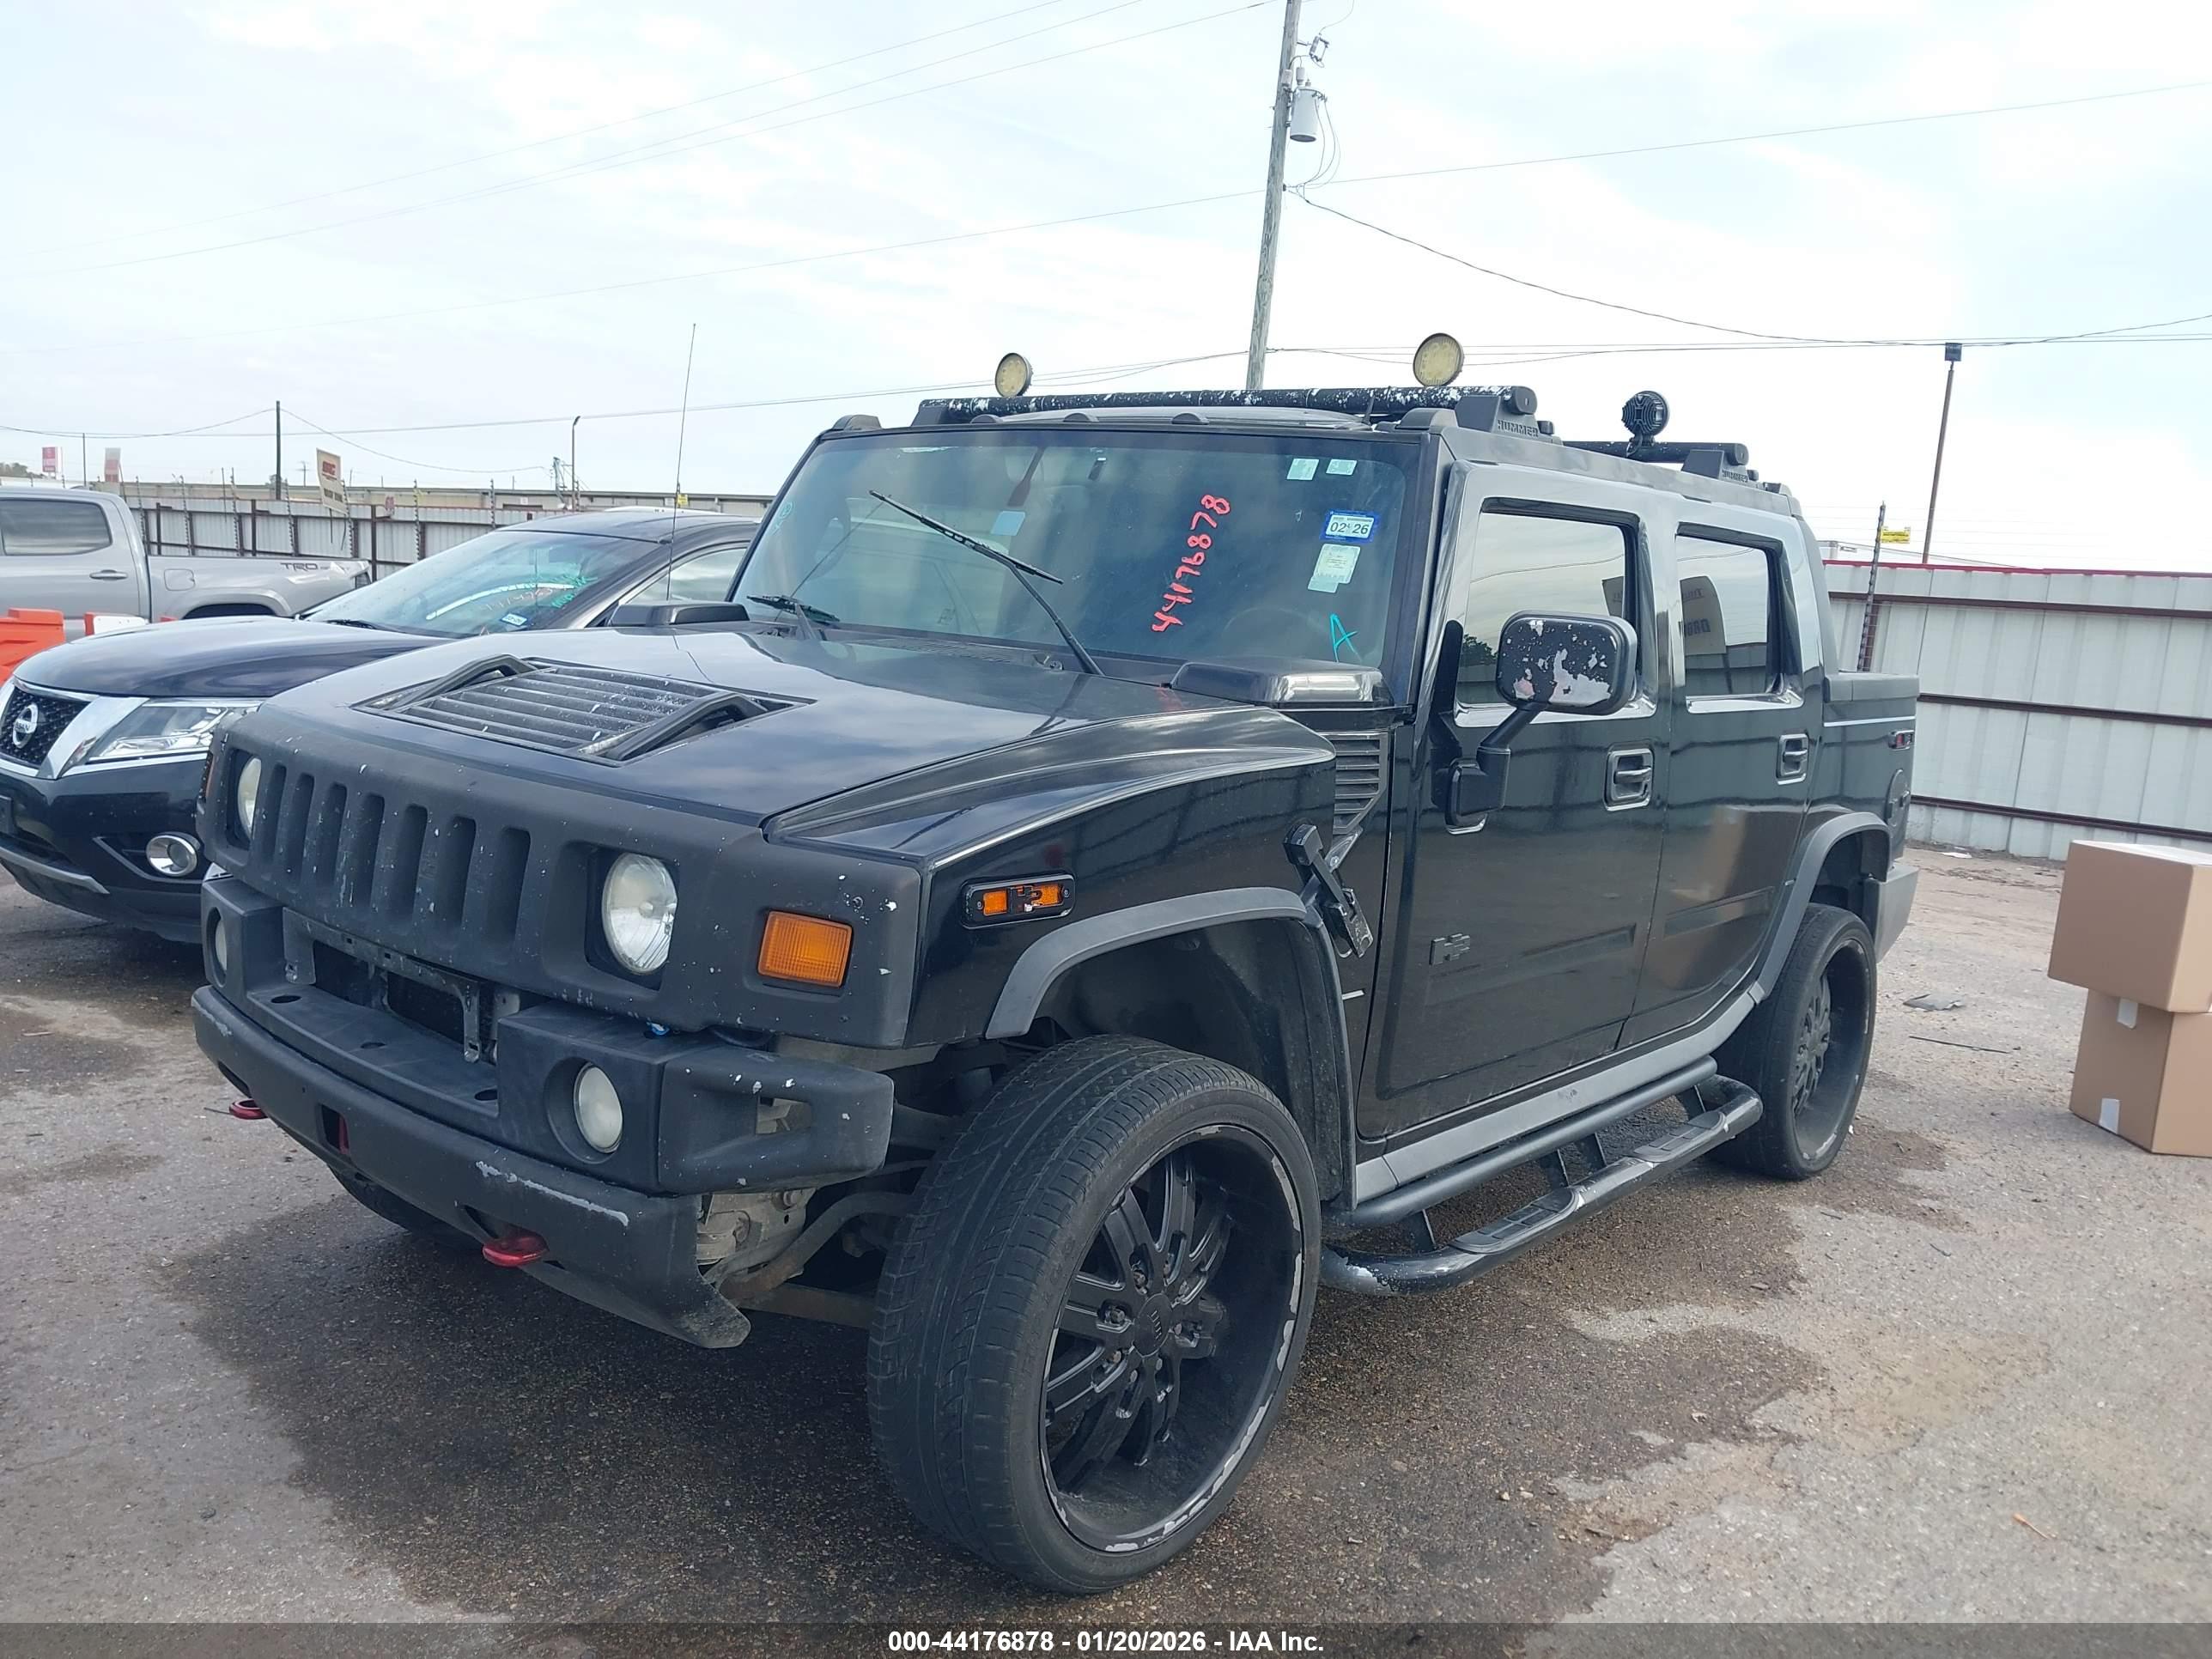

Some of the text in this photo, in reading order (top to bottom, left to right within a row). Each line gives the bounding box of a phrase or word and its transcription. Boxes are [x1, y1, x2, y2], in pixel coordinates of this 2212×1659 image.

[1498, 419, 1539, 438] HUMMER
[1330, 521, 1370, 535] 02 26
[1152, 494, 1231, 632] 44176878
